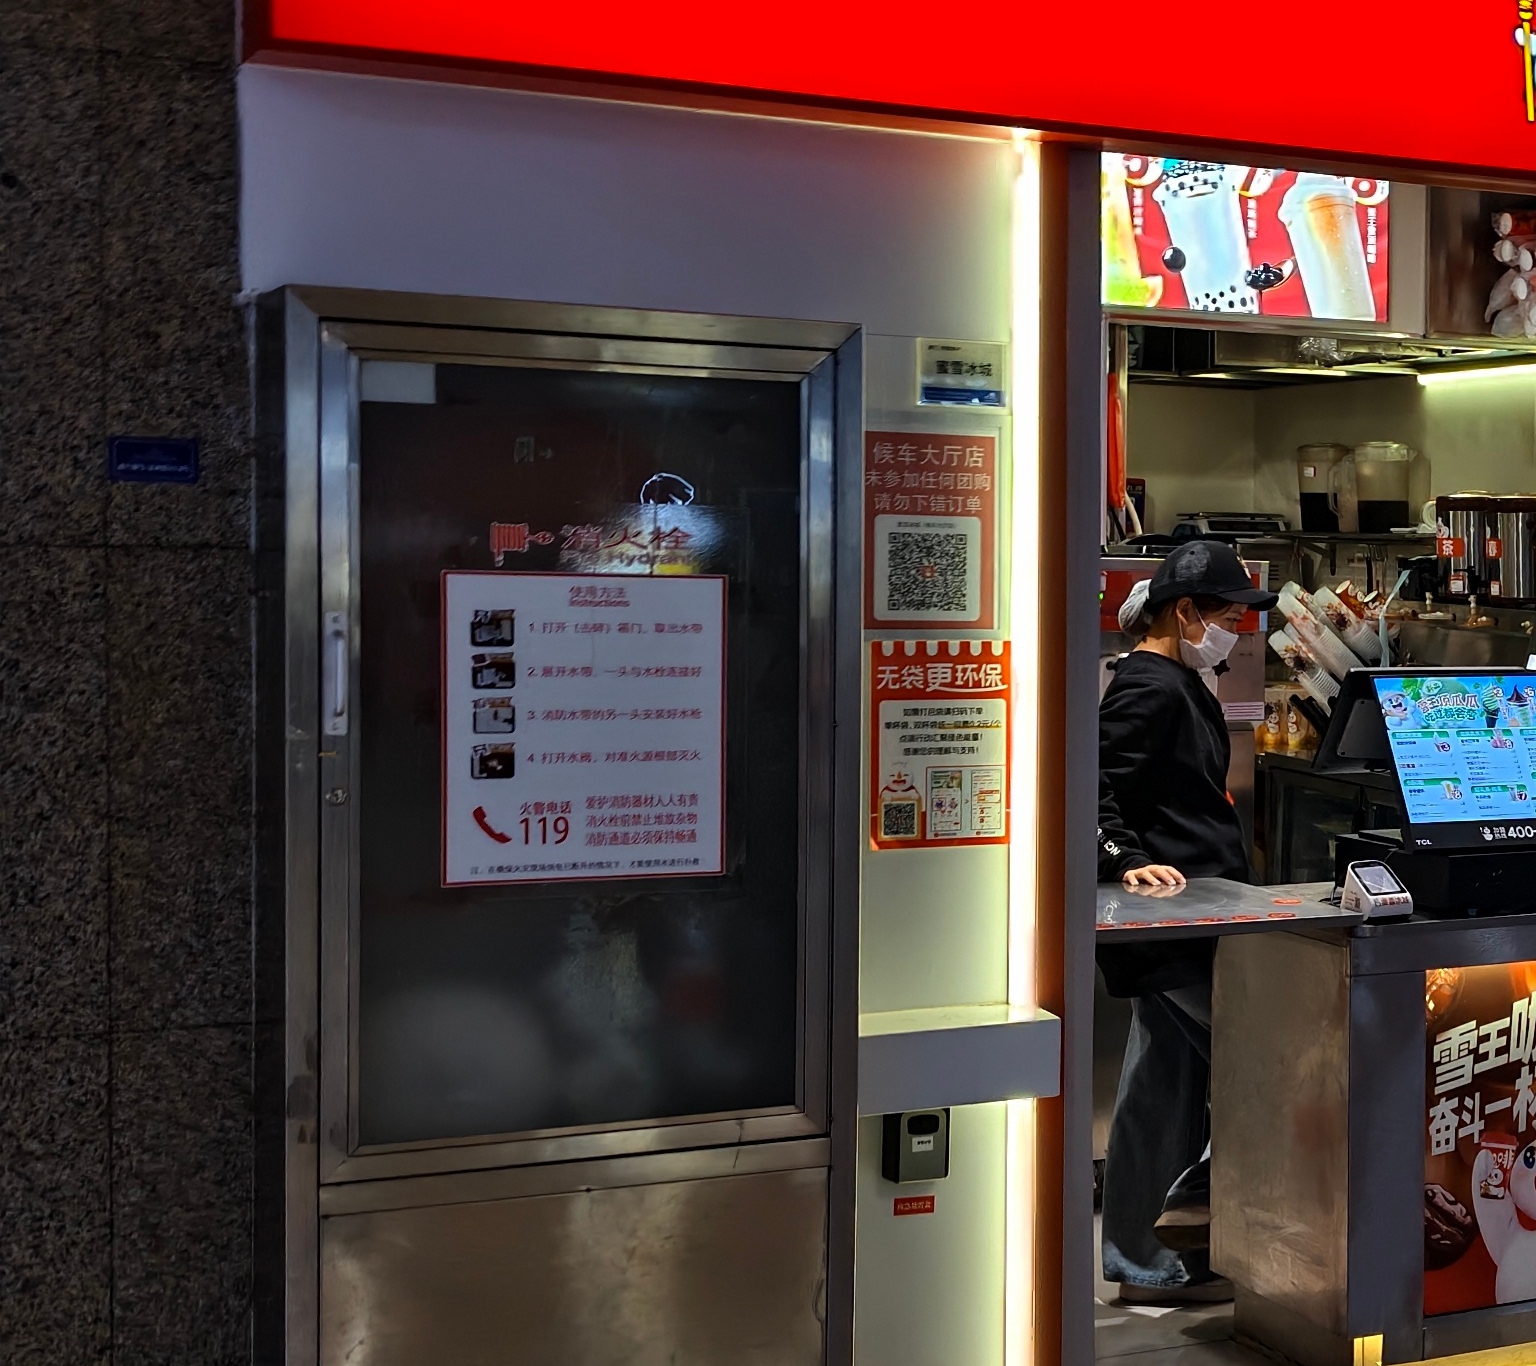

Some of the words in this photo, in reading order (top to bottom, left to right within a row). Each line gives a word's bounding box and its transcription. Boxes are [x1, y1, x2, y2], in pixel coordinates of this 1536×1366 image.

[873, 441, 985, 467] 候车大厅店
[865, 469, 991, 491] 未参加任何团购
[874, 492, 983, 513] 请勿下错订单
[876, 663, 1007, 692] 无袋更环保
[519, 800, 572, 815] 火警电话
[519, 816, 570, 845] 119
